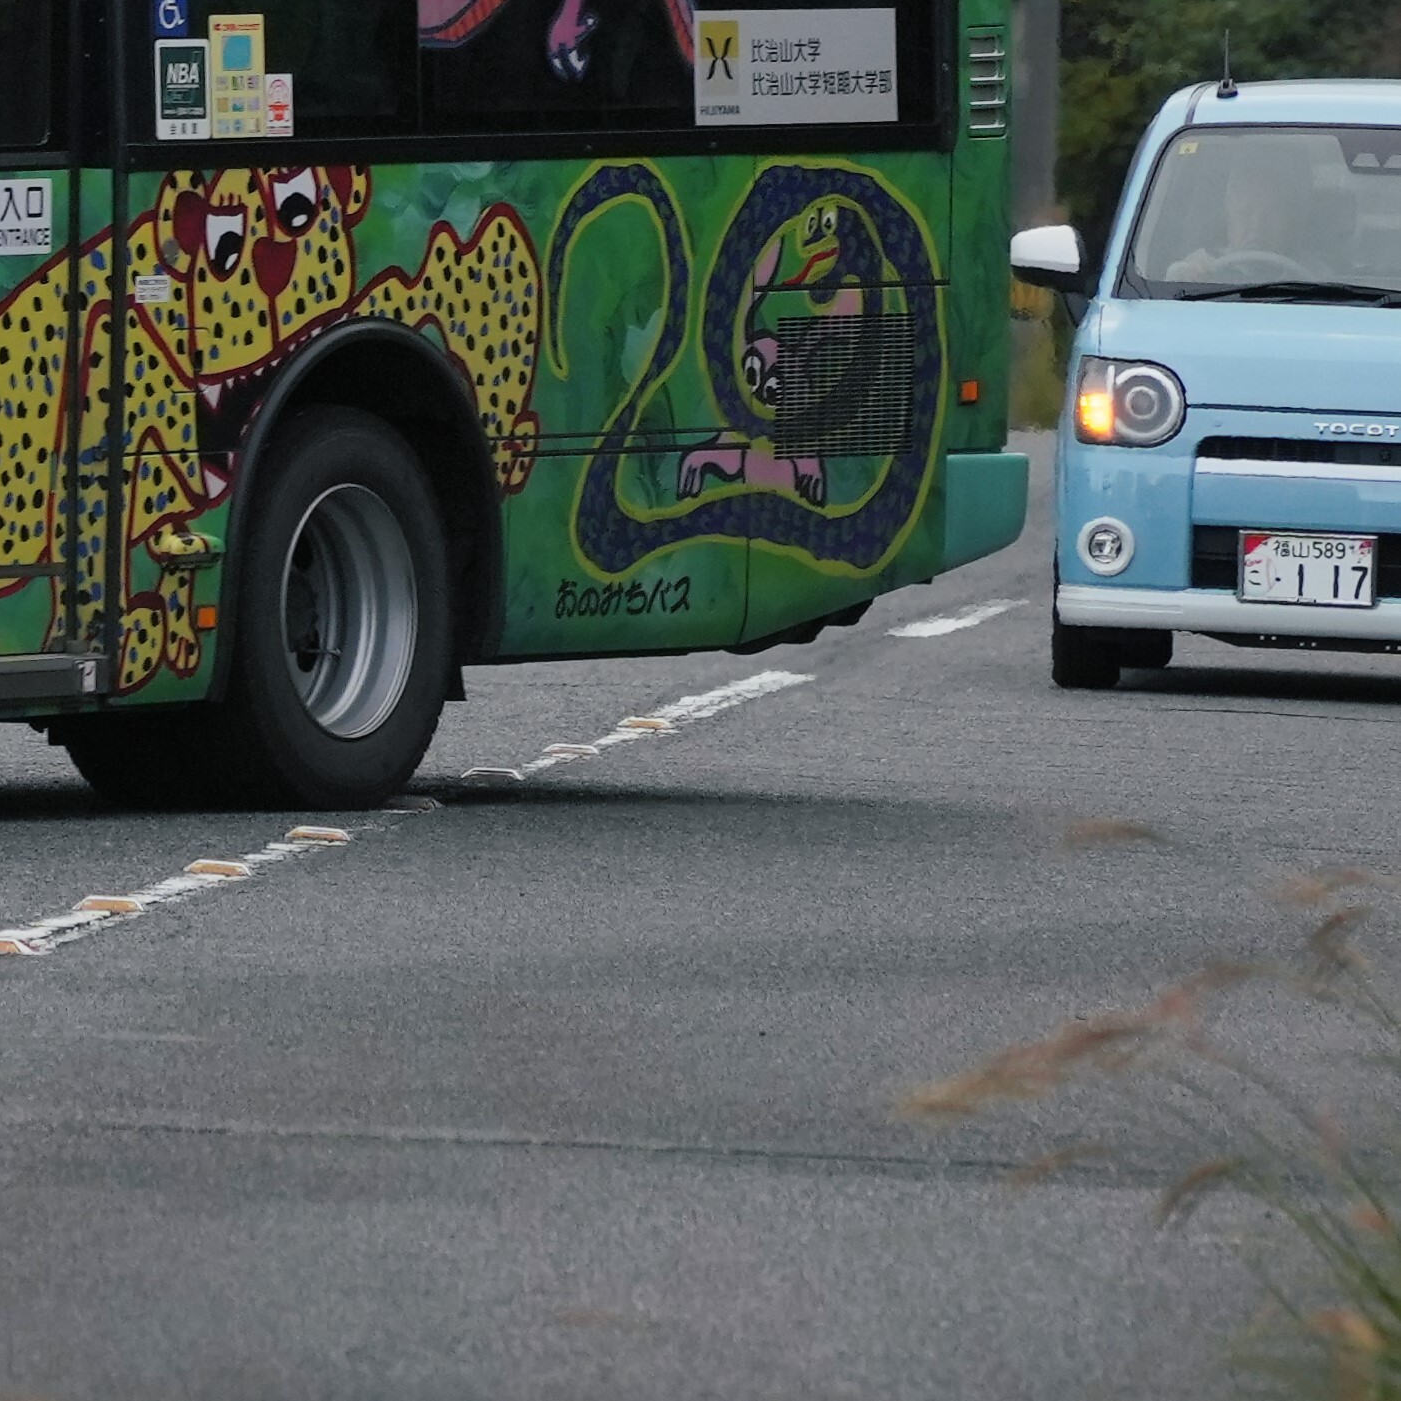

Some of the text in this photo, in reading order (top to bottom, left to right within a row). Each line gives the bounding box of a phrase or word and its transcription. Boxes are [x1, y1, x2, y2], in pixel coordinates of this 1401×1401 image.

[751, 37, 821, 63] 比治山大学
[166, 61, 200, 84] NBA
[751, 69, 893, 96] 比治山大学短期大学部
[0, 186, 44, 222] 入口
[1313, 422, 1400, 437] TOCOT
[555, 575, 691, 619] おのみちバス
